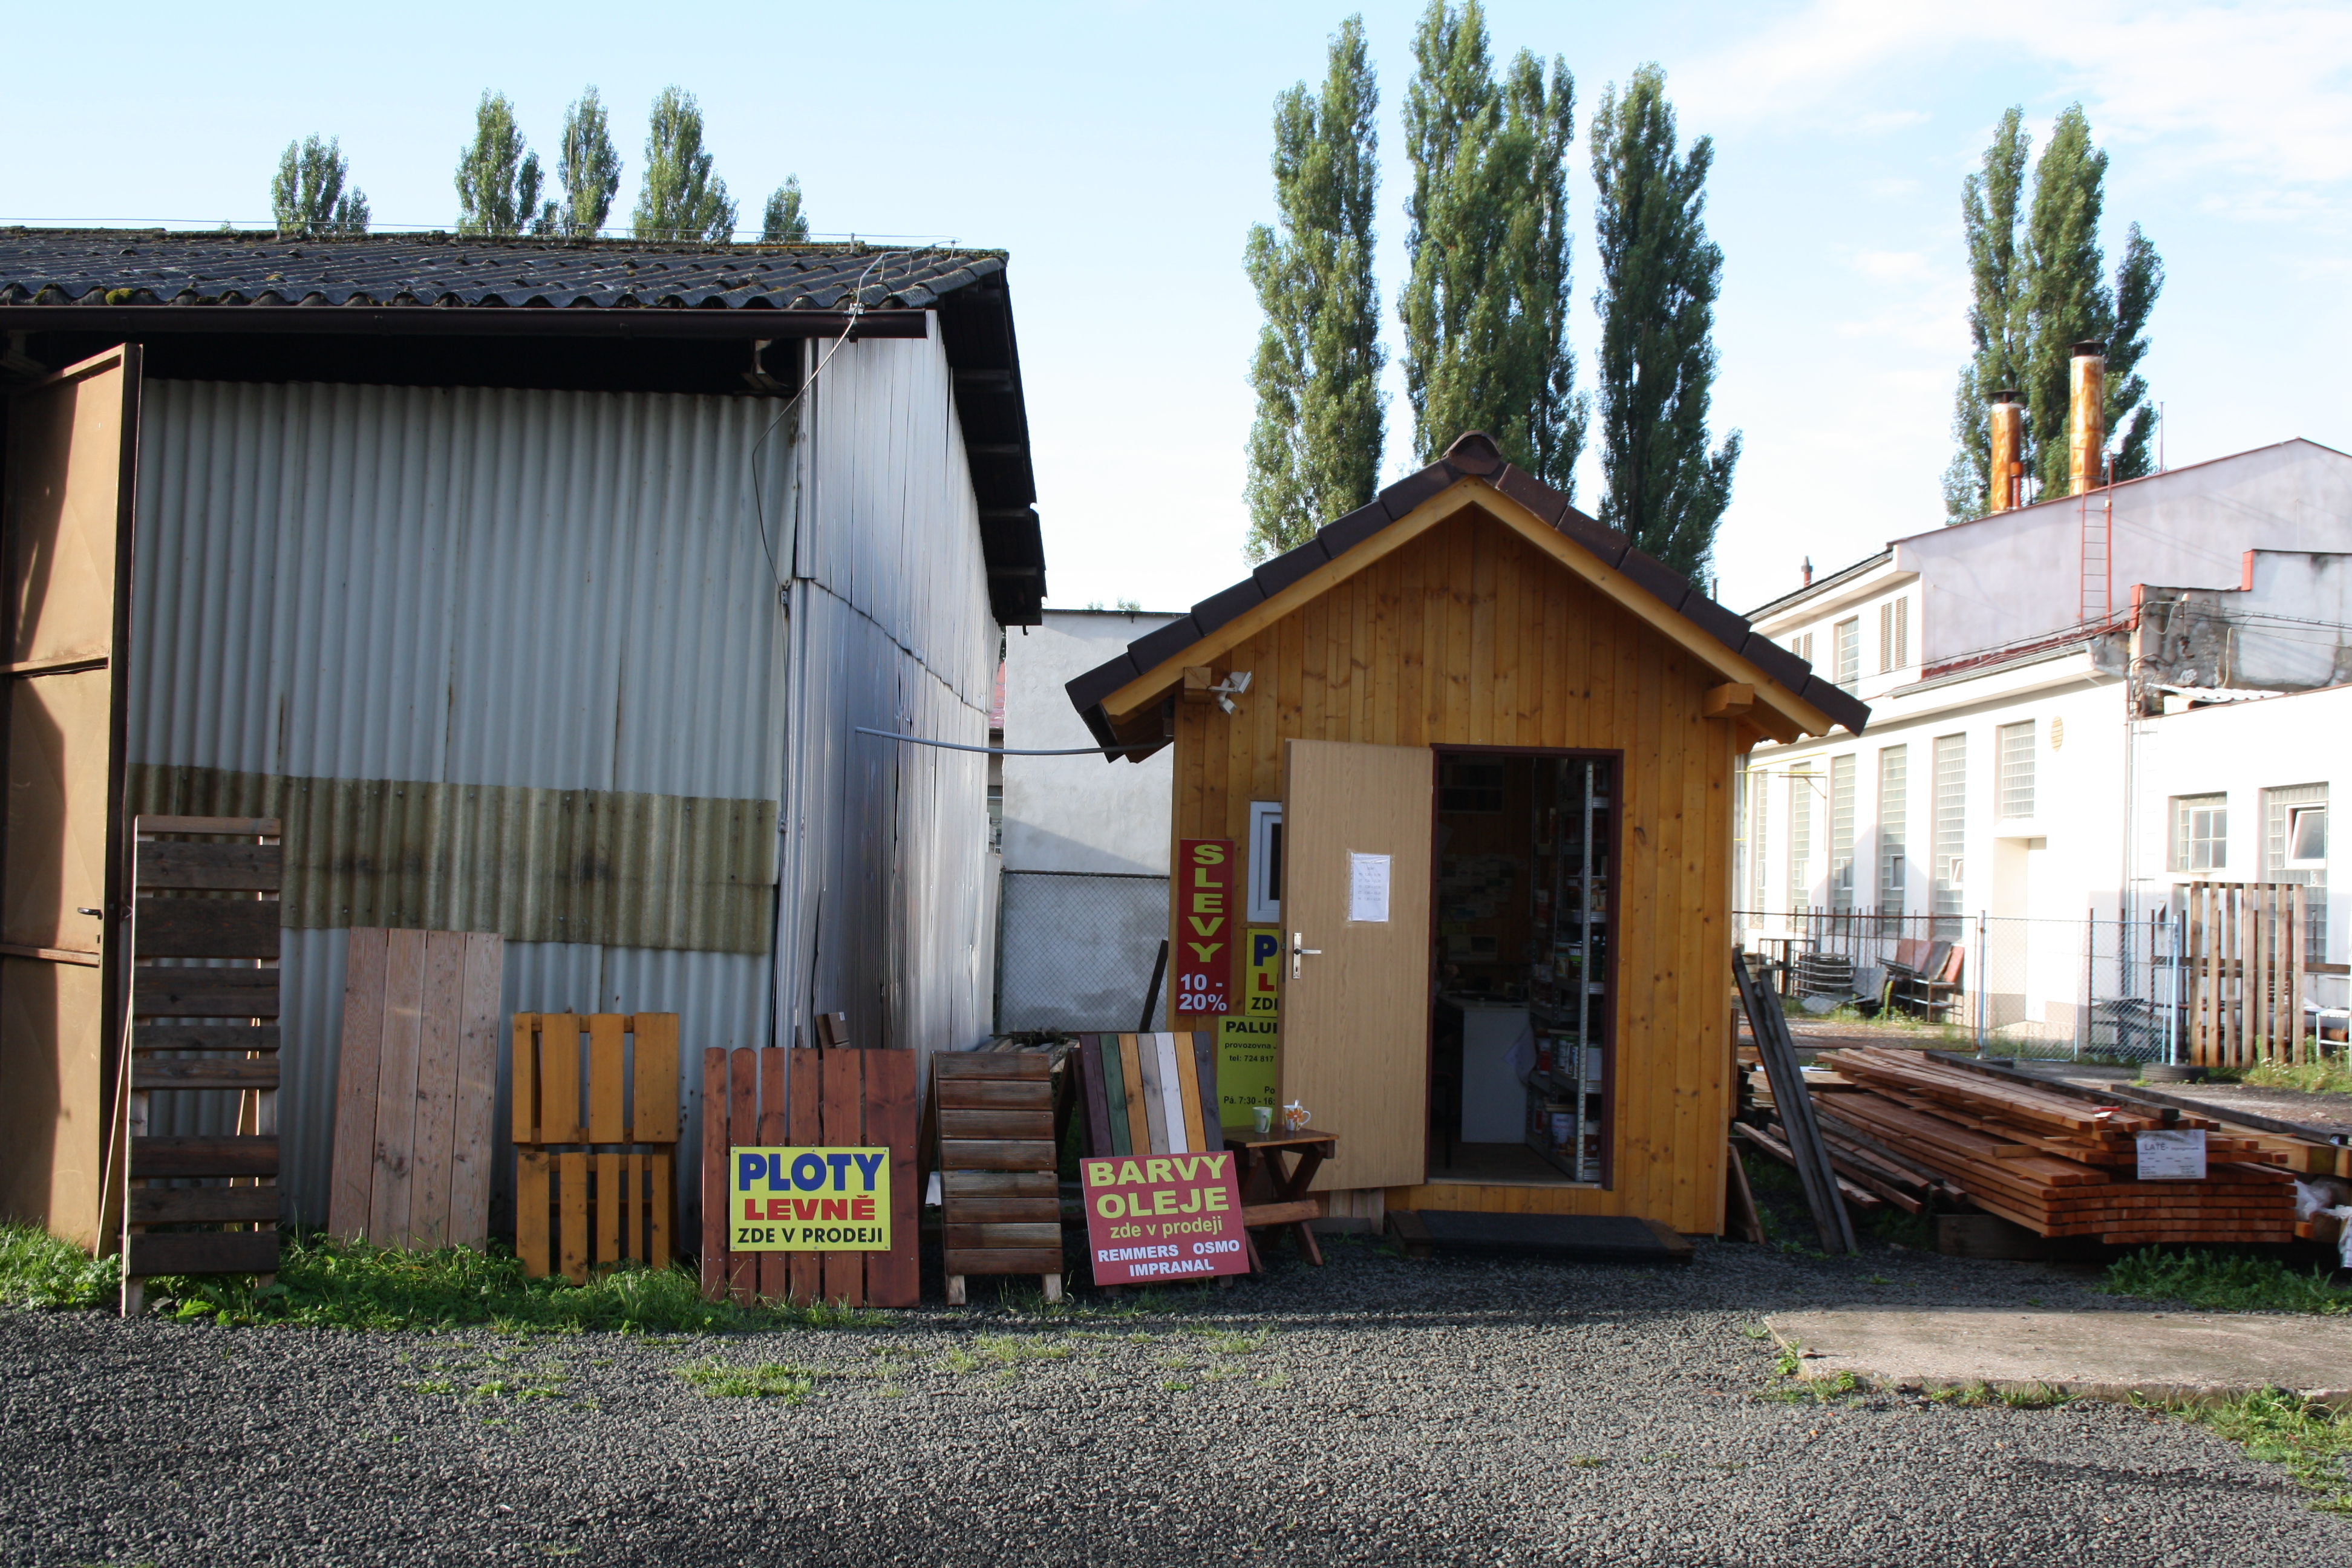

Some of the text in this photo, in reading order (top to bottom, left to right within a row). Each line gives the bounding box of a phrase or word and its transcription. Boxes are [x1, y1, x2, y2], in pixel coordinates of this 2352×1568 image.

[1187, 844, 1225, 963] SLEVY
[1180, 973, 1207, 990] 10
[1258, 973, 1278, 991] L
[1179, 993, 1227, 1011] 20%
[1224, 1096, 1236, 1104] Pá.
[738, 1152, 885, 1191] PLOTY
[1088, 1154, 1228, 1187] BARVY
[744, 1195, 875, 1221] LEVNĚ
[1096, 1186, 1229, 1218] OLEJE
[737, 1227, 883, 1243] ZDE V PRODEJI
[1110, 1215, 1223, 1239] zde v prodeji
[1097, 1239, 1240, 1263] REMMERS OSMO
[1129, 1259, 1214, 1276] IMPRANAL
